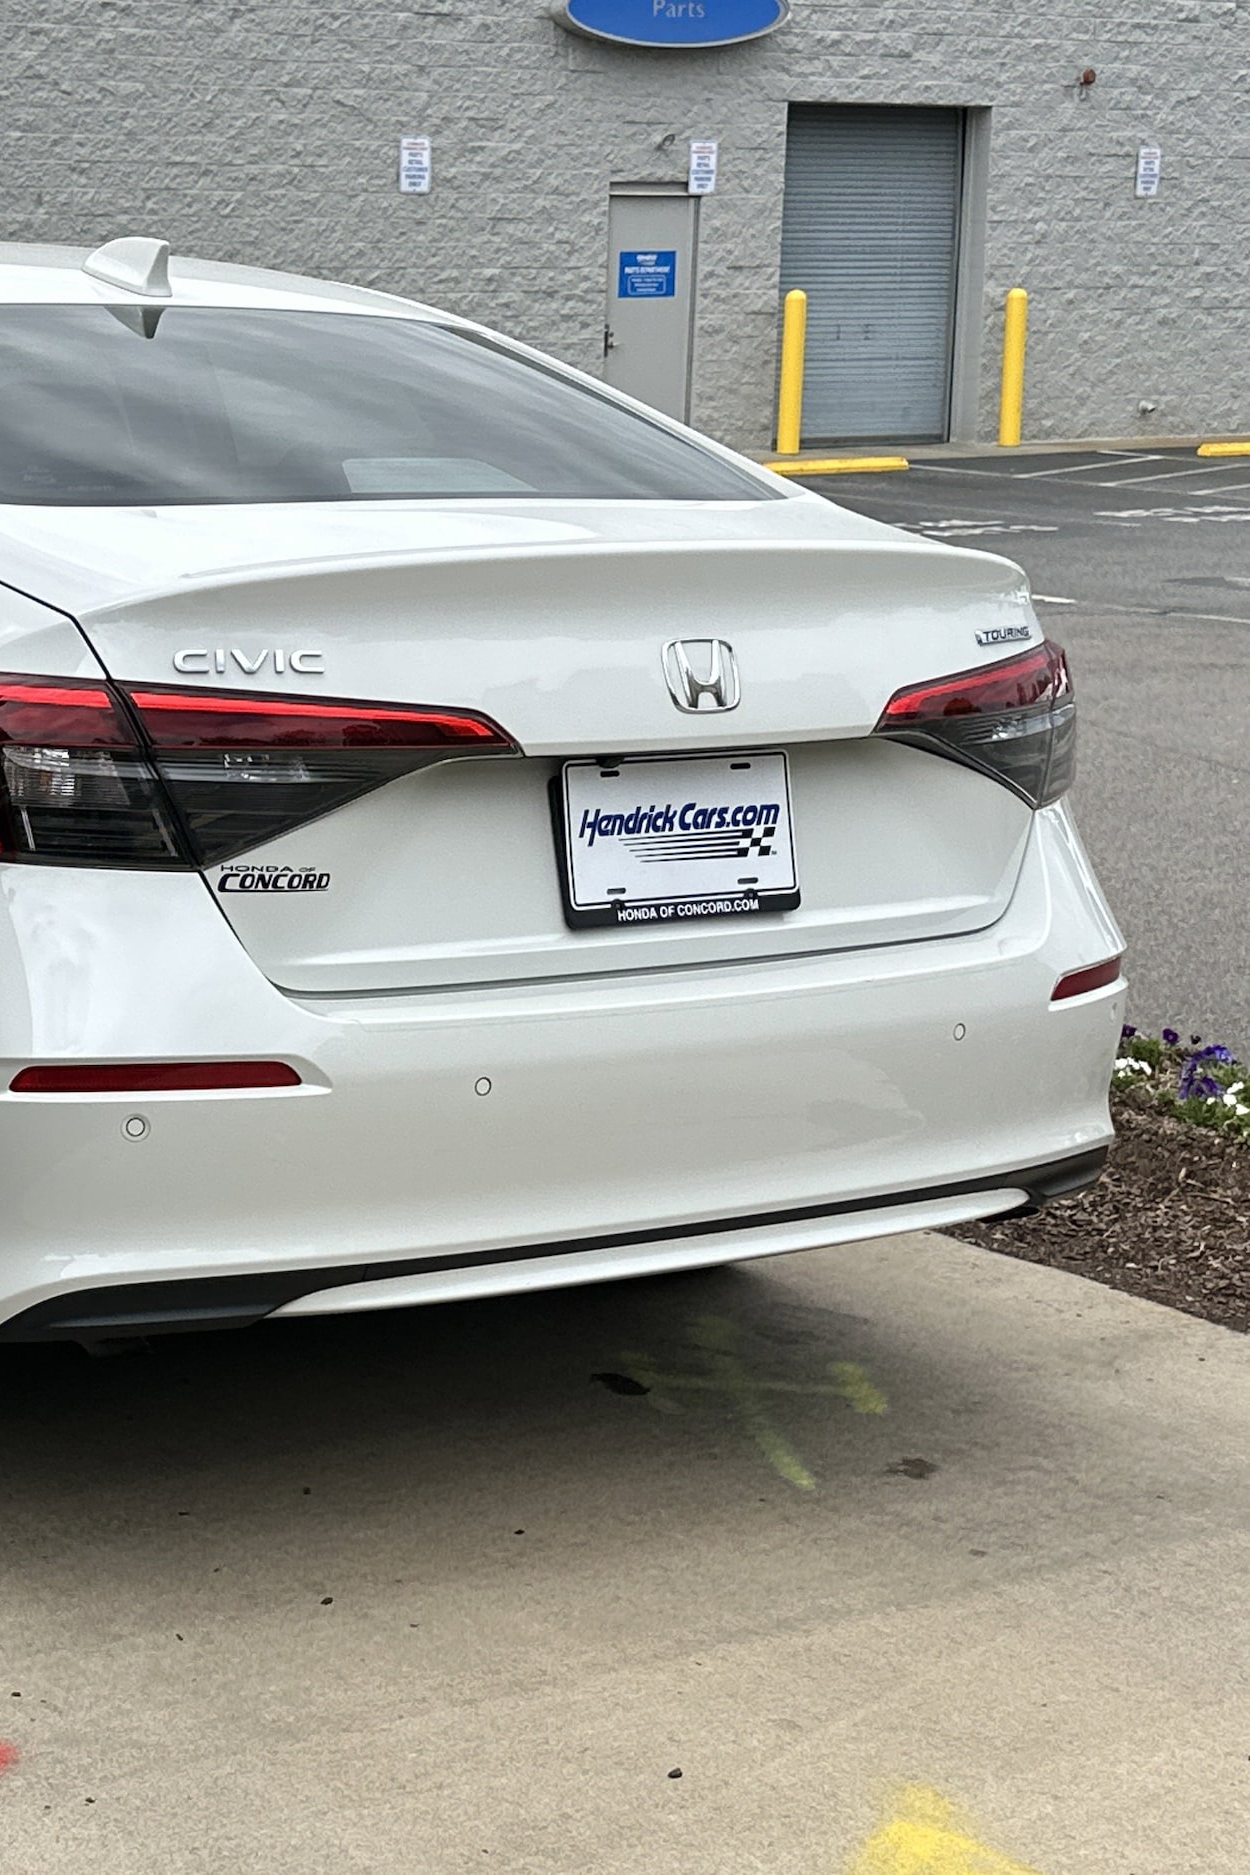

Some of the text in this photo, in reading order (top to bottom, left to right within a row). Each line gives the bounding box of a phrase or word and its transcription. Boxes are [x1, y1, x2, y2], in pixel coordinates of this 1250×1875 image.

[652, 0, 706, 18] Parts
[982, 626, 1030, 642] TOURING
[173, 649, 325, 675] CIVIC
[220, 864, 294, 873] HONDA
[217, 873, 331, 892] CONCORD
[617, 899, 760, 922] HONDA OF CONCORD.COM
